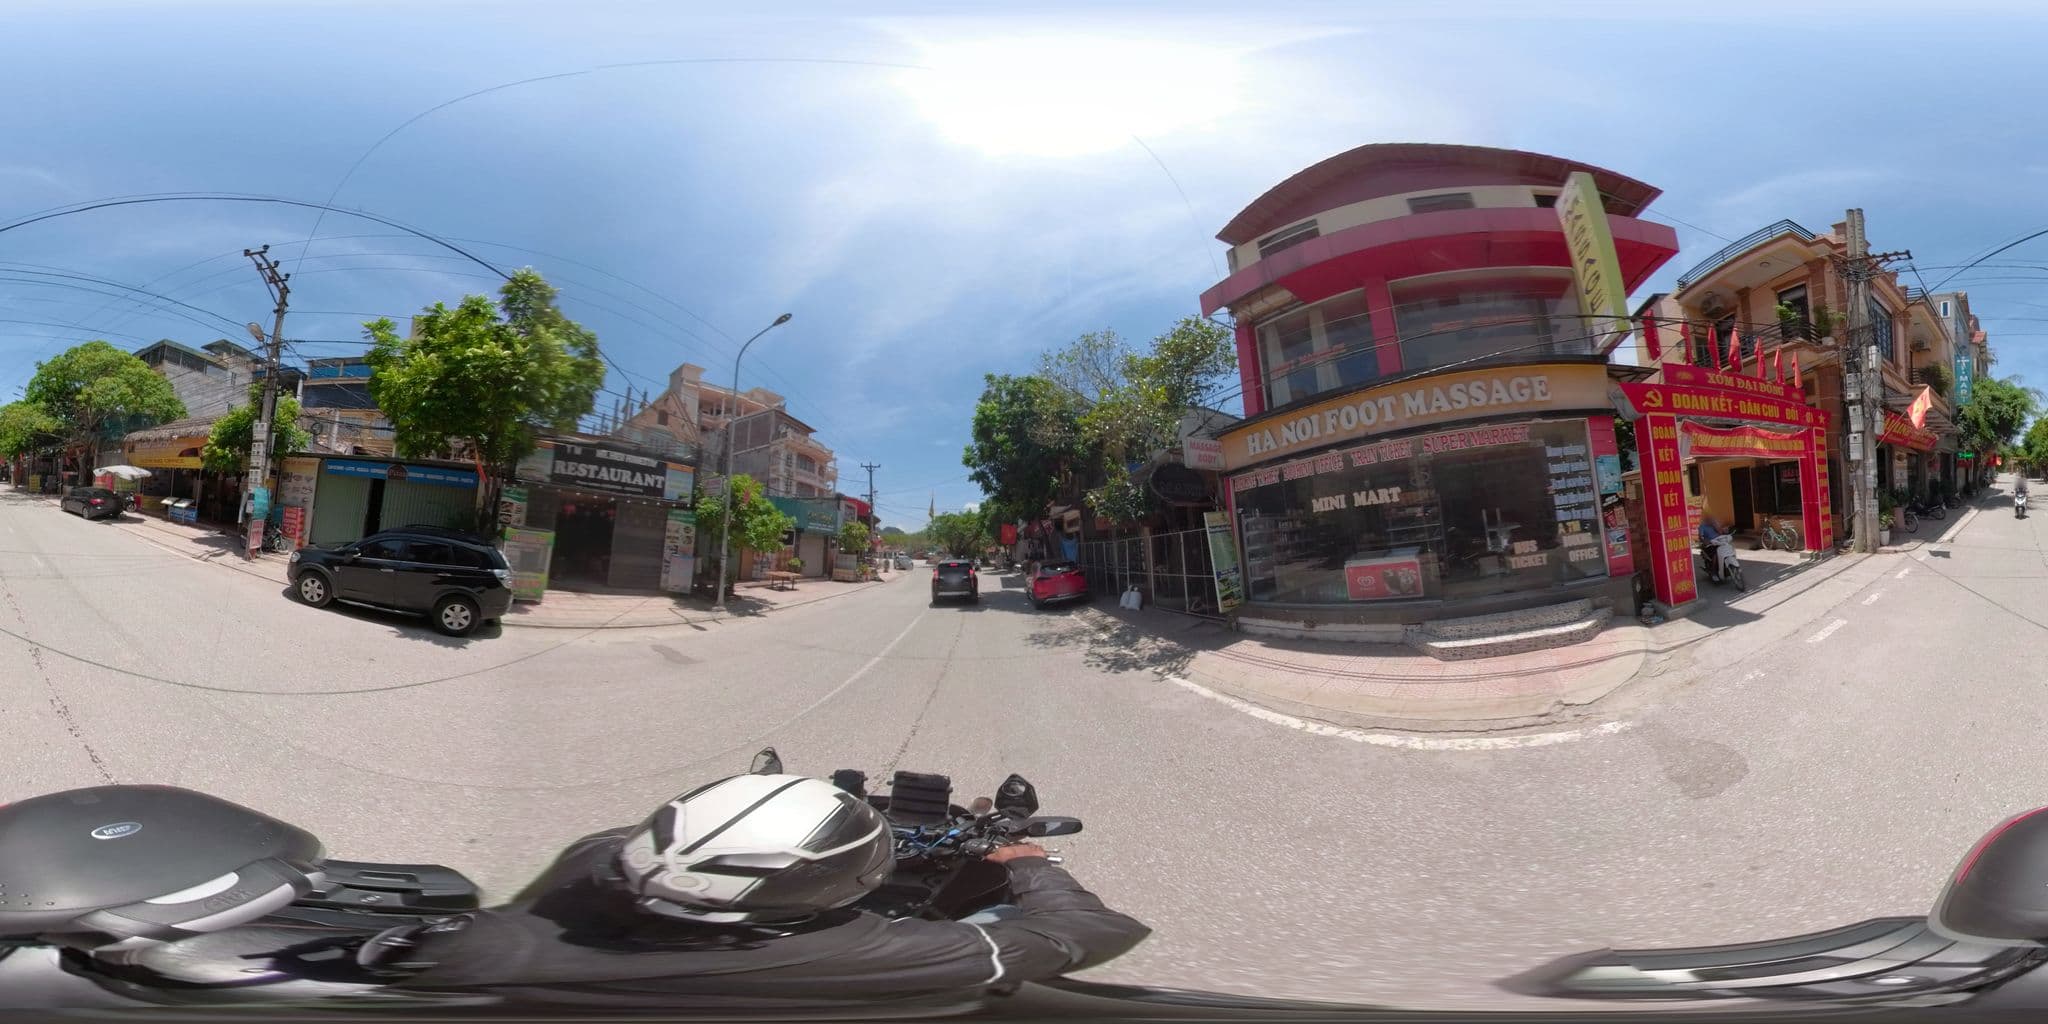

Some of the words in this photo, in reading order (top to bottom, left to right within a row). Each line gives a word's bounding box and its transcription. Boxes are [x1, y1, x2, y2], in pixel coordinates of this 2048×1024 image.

[1672, 390, 1710, 411] ĐOÀN
[1711, 392, 1733, 412] KẾT
[1247, 429, 1277, 456] HA
[1281, 414, 1320, 446] NOI
[1324, 396, 1396, 430] FOOT
[1403, 376, 1550, 416] MASSAGE
[1188, 440, 1221, 453] MASSAGE
[1423, 431, 1469, 454] SUPER
[1470, 424, 1529, 448] MARKET
[1658, 445, 1674, 462] KẾT
[554, 460, 665, 489] RESTAURANT
[1312, 494, 1346, 513] MINI
[1353, 486, 1401, 507] MART
[1663, 488, 1679, 507] KẾT
[1514, 540, 1537, 555] BUS
[1568, 546, 1600, 562] OFFICE
[1511, 553, 1548, 570] TICKET
